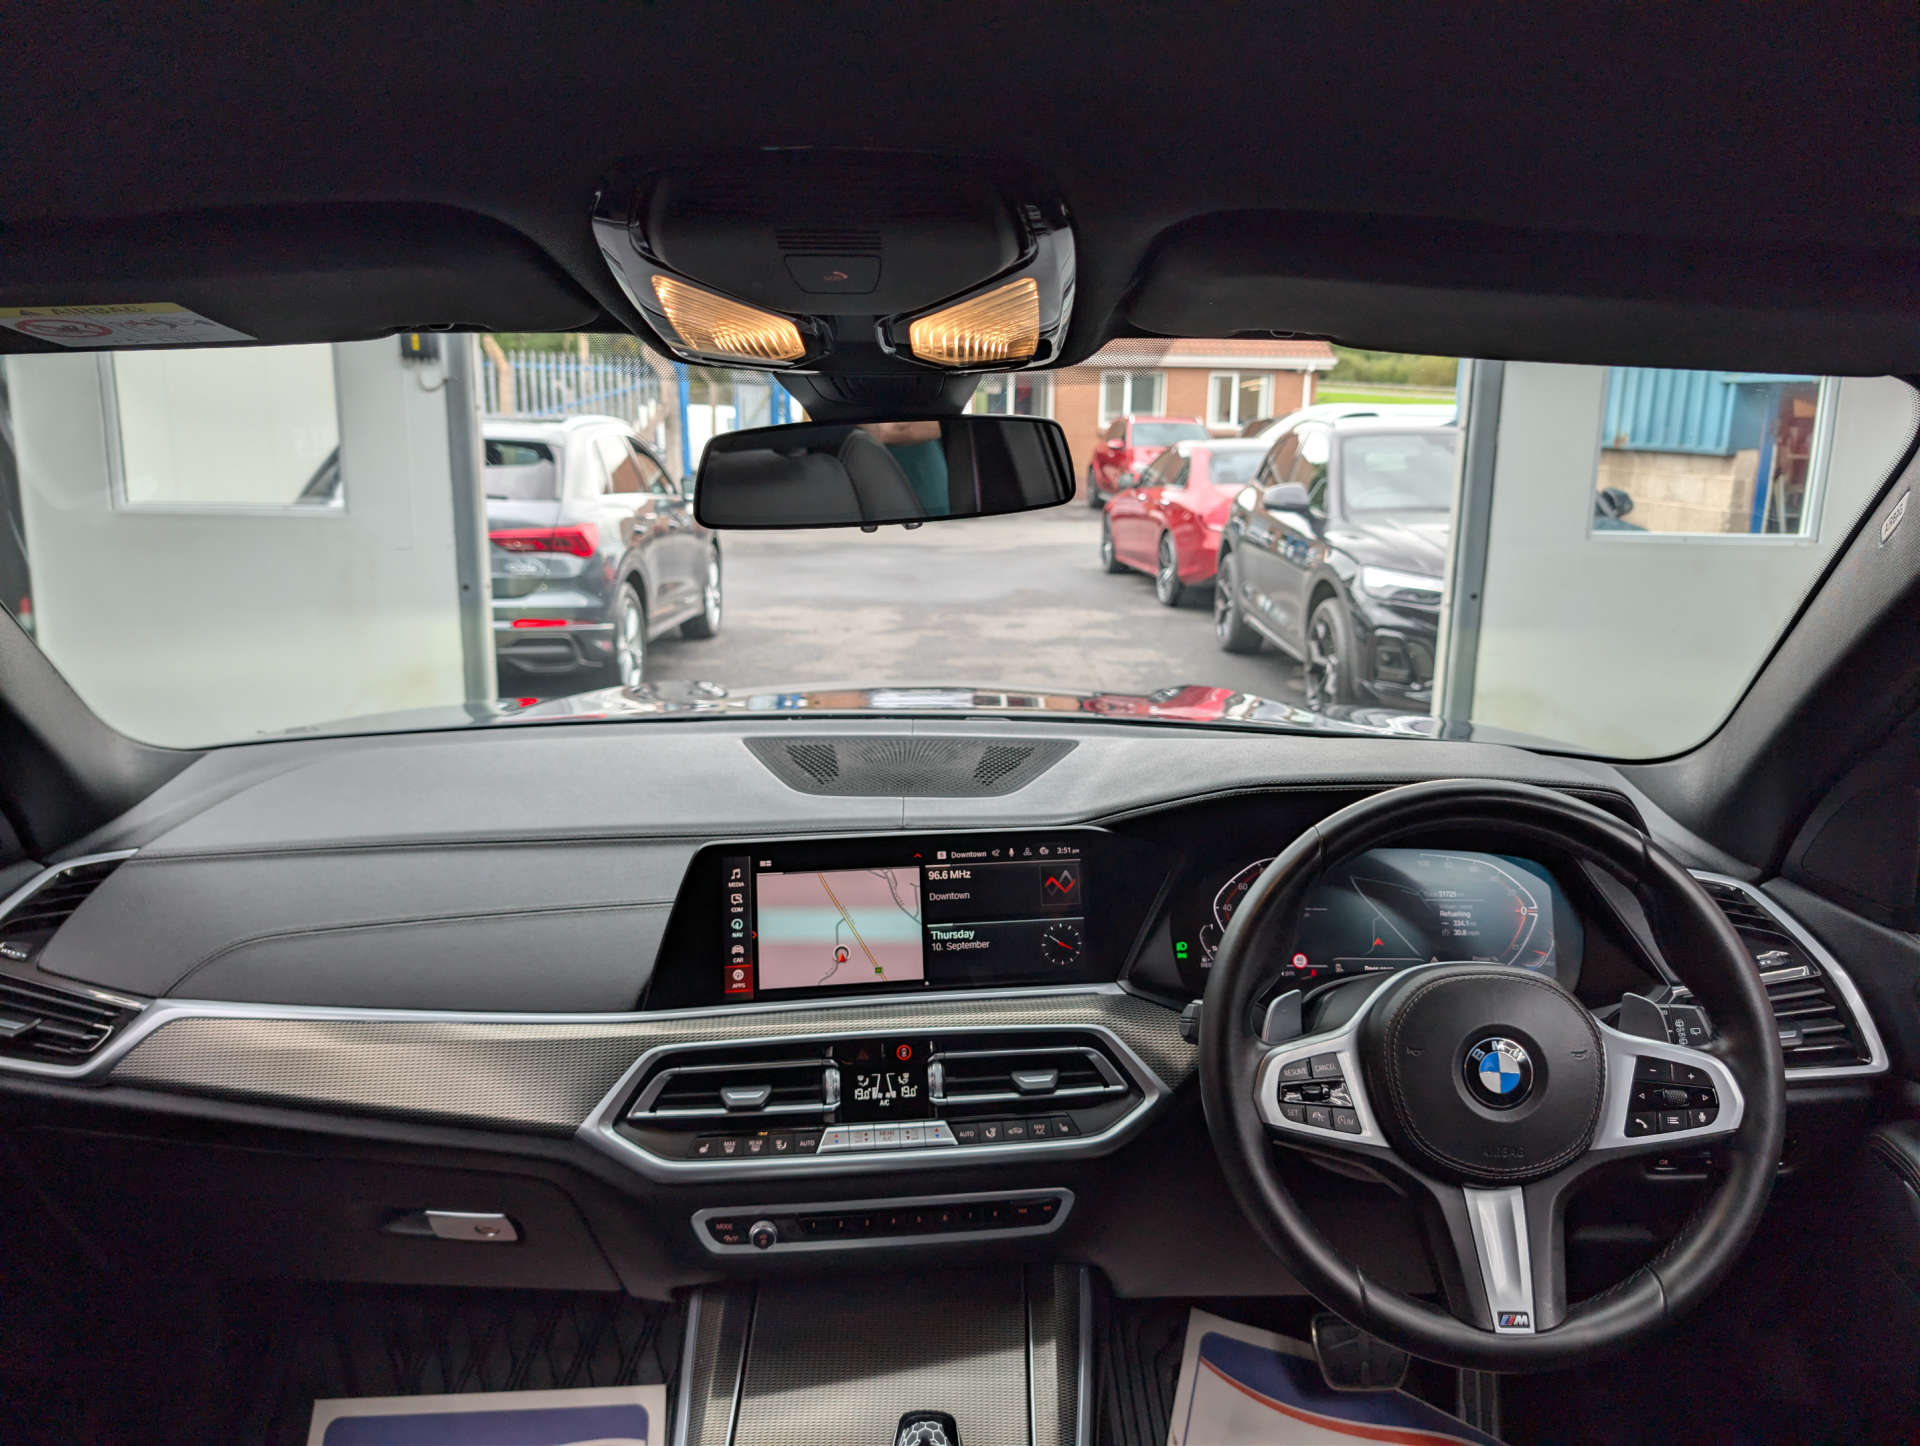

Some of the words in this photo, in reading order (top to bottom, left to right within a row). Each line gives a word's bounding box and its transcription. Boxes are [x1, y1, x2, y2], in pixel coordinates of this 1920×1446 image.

[951, 850, 987, 858] Downtown
[928, 870, 949, 880] 96.6
[950, 869, 972, 879] MHz
[929, 892, 971, 901] Downtown
[1520, 906, 1527, 915] 0
[930, 929, 975, 940] Thursday
[931, 943, 943, 951] 10.
[946, 940, 990, 951] September
[1472, 1040, 1527, 1061] BMW
